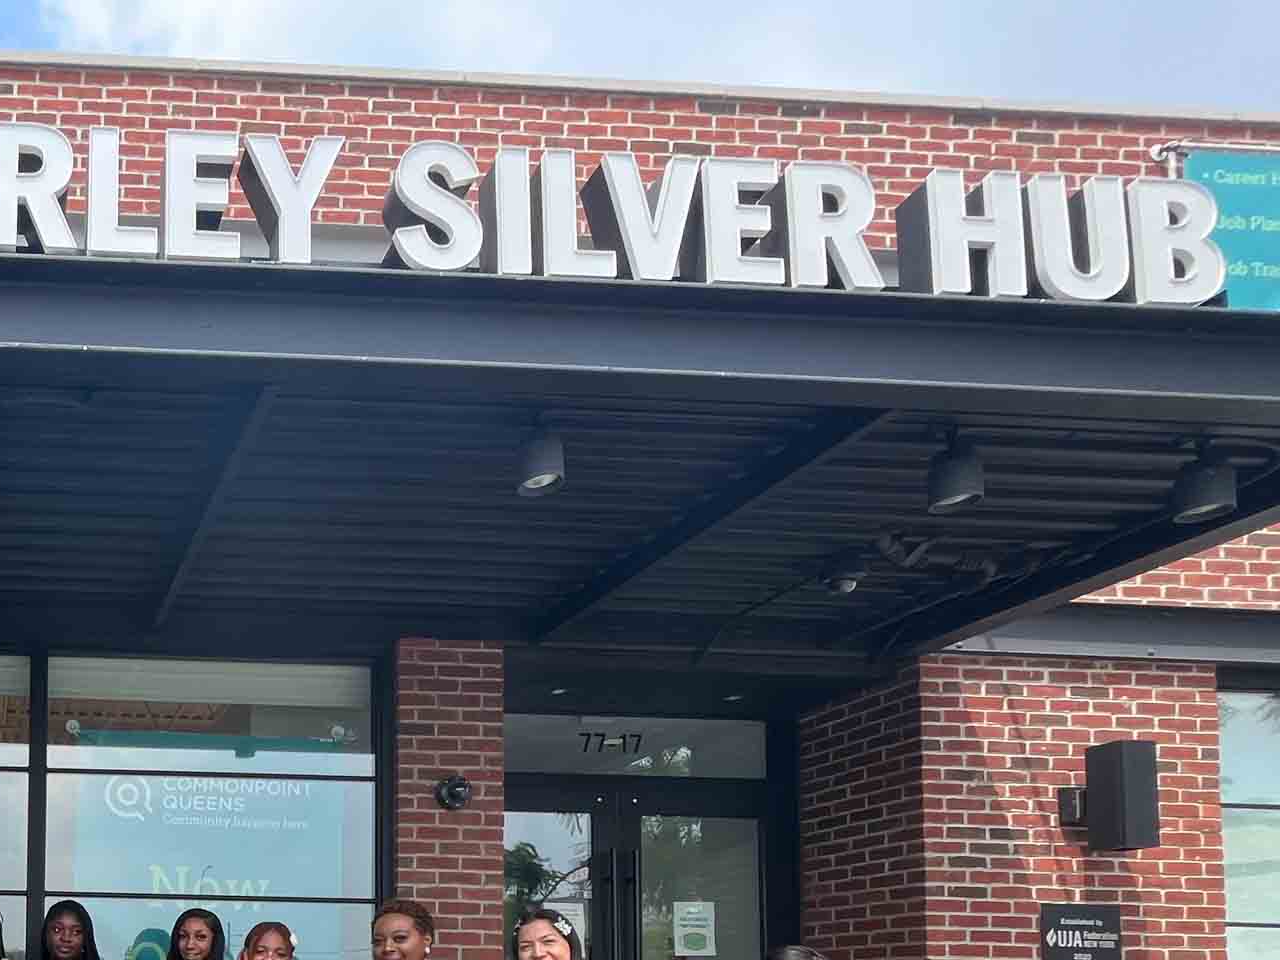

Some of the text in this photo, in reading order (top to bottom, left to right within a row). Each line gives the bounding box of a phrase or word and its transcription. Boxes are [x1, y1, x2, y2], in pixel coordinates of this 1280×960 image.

[388, 138, 885, 290] SILVER
[924, 167, 1227, 306] HUB
[1229, 260, 1248, 277] ob
[163, 795, 246, 812] QUEENS
[1057, 930, 1082, 948] UJA
